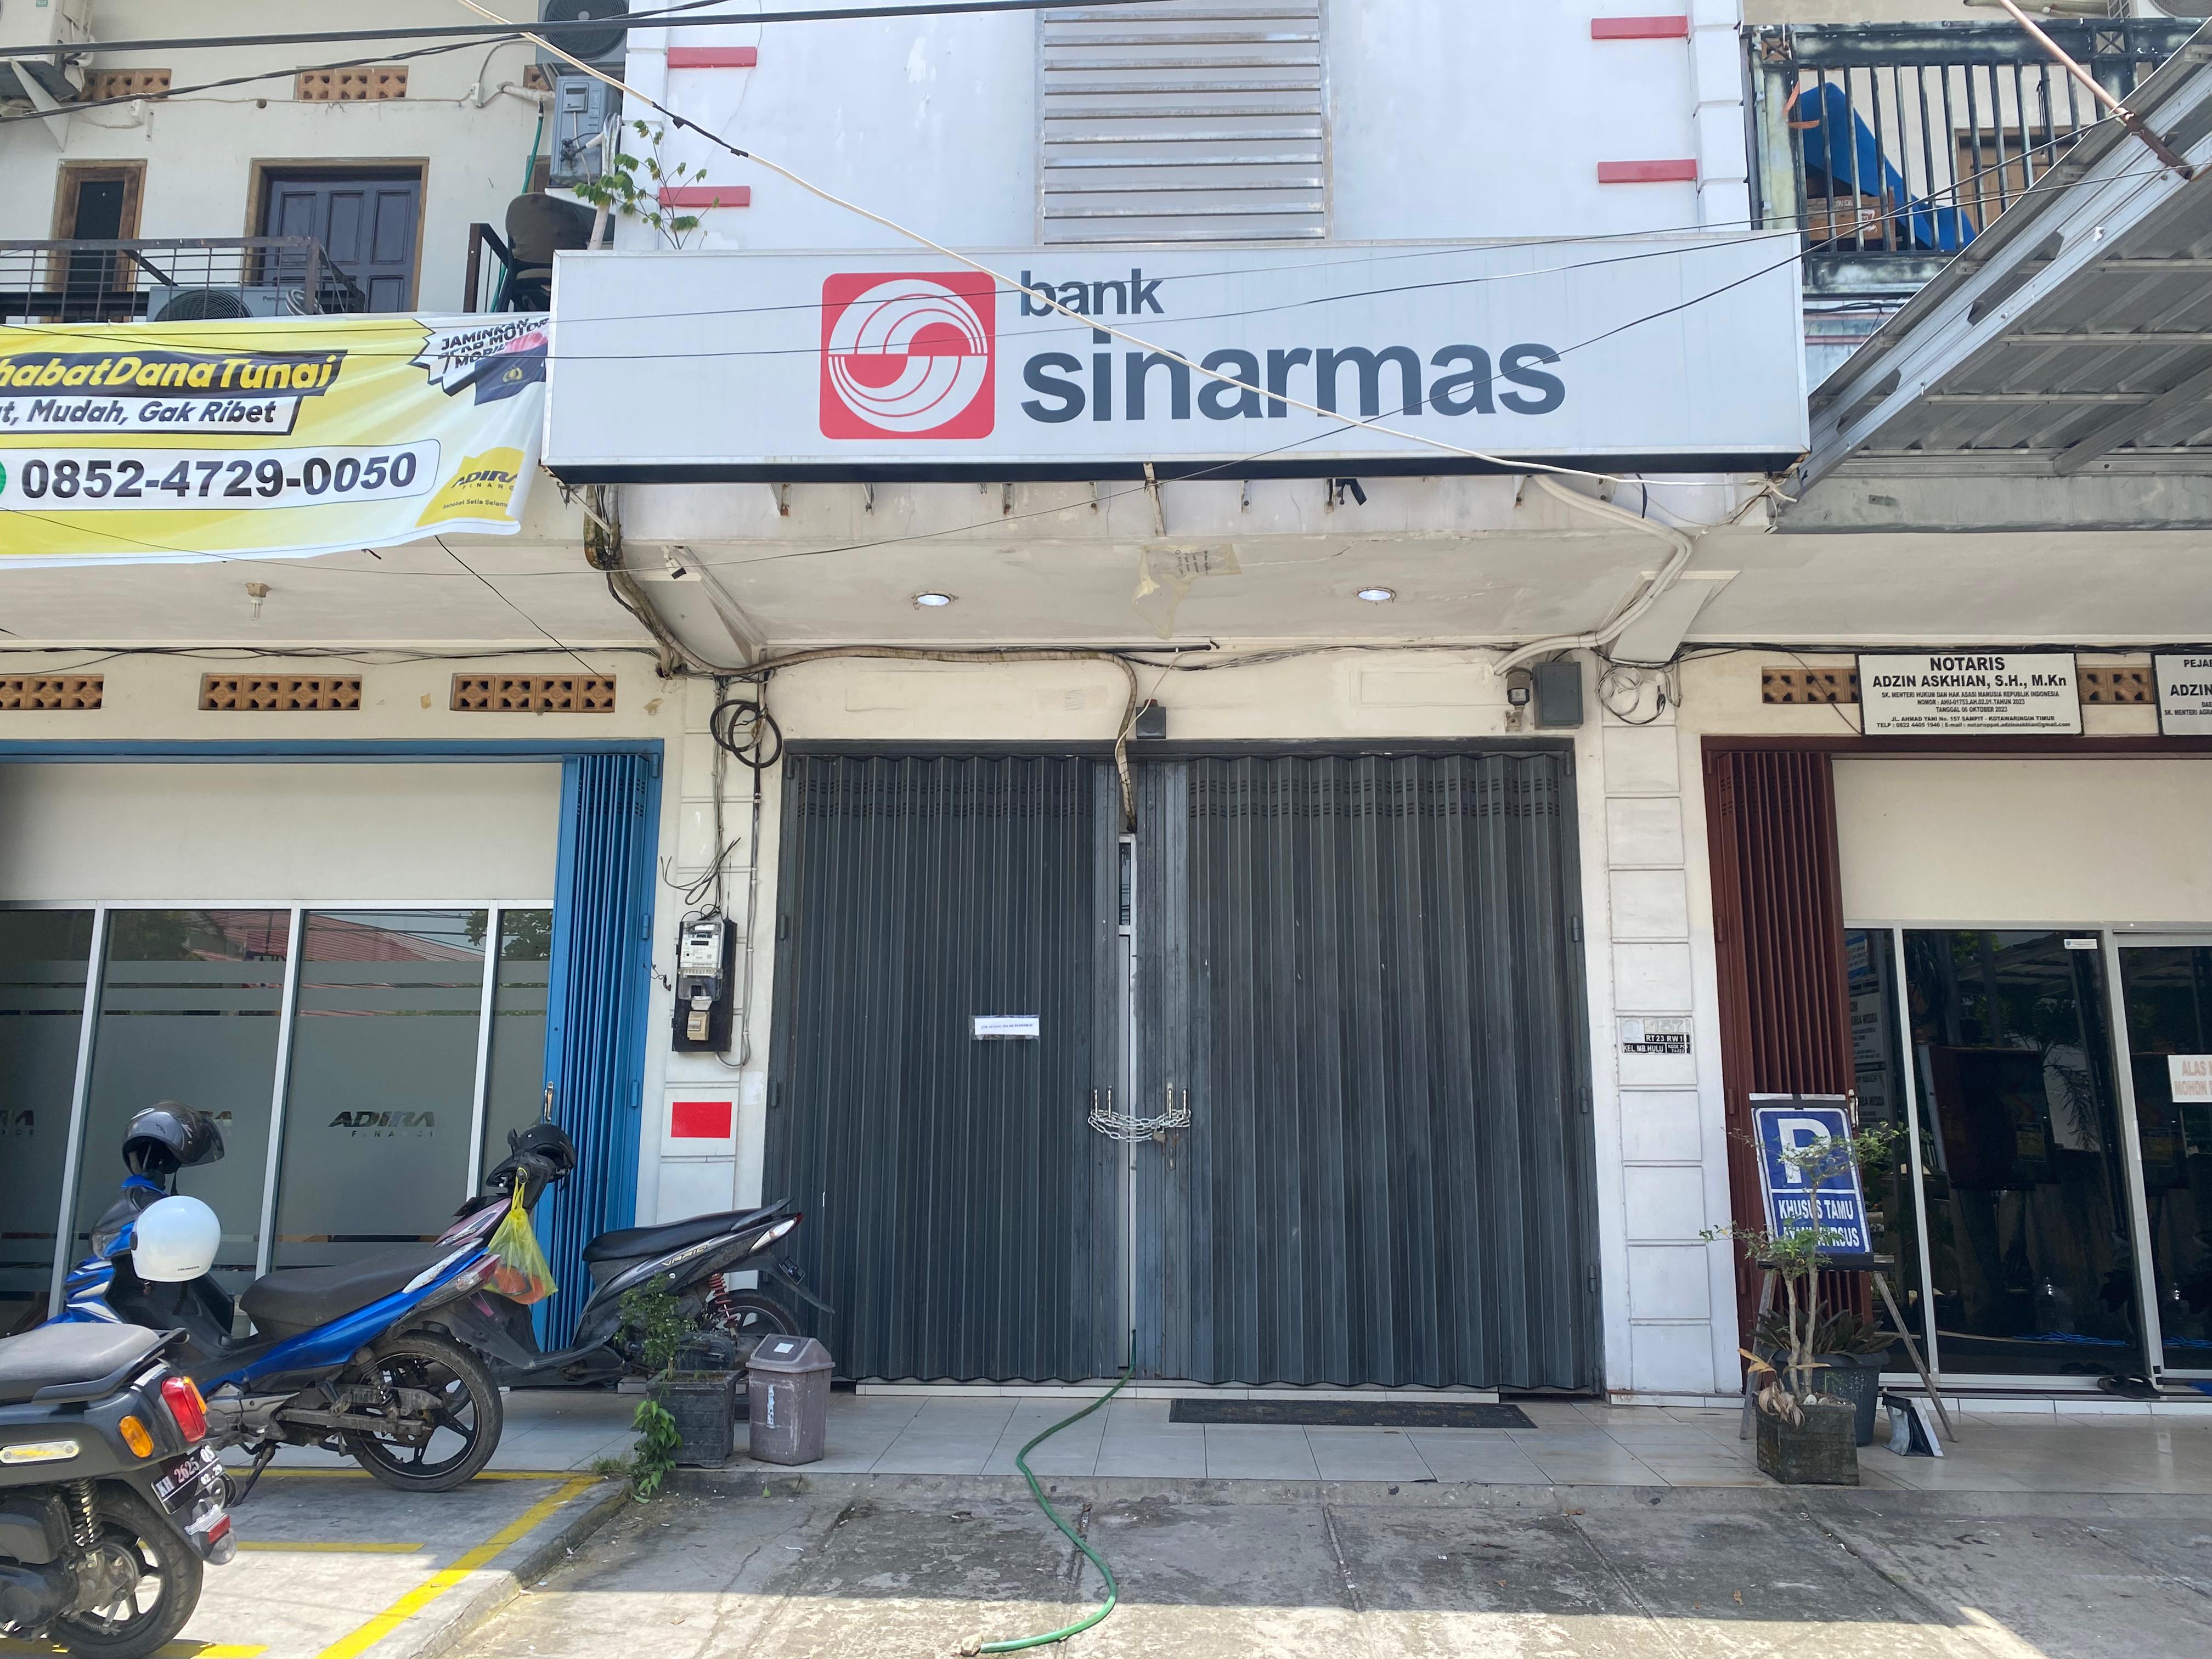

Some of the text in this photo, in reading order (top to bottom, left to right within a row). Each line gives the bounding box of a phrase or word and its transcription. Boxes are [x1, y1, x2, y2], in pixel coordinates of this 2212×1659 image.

[1020, 268, 1165, 317] bank
[441, 318, 529, 350] JAMINKAN
[1020, 326, 1566, 424] sinarmas
[26, 399, 128, 425] Mudah,
[138, 400, 196, 422] Gak
[203, 400, 276, 423] Ribet
[21, 452, 416, 498] 0852-4729-0050
[1930, 657, 2005, 671] NOTARIS
[1872, 674, 2067, 690] ADZIN ASKHIAN, S.H., M.Kn
[1650, 1020, 1684, 1032] 157
[2182, 1060, 2207, 1076] ALAS
[2174, 1080, 2207, 1096] MOHON
[328, 1111, 436, 1127] ADIRA
[1778, 1118, 1832, 1183] P
[1824, 1200, 1854, 1220] TAMU
[661, 1245, 708, 1267] VARIO
[155, 1476, 174, 1498] KH
[173, 1456, 200, 1483] 2625
